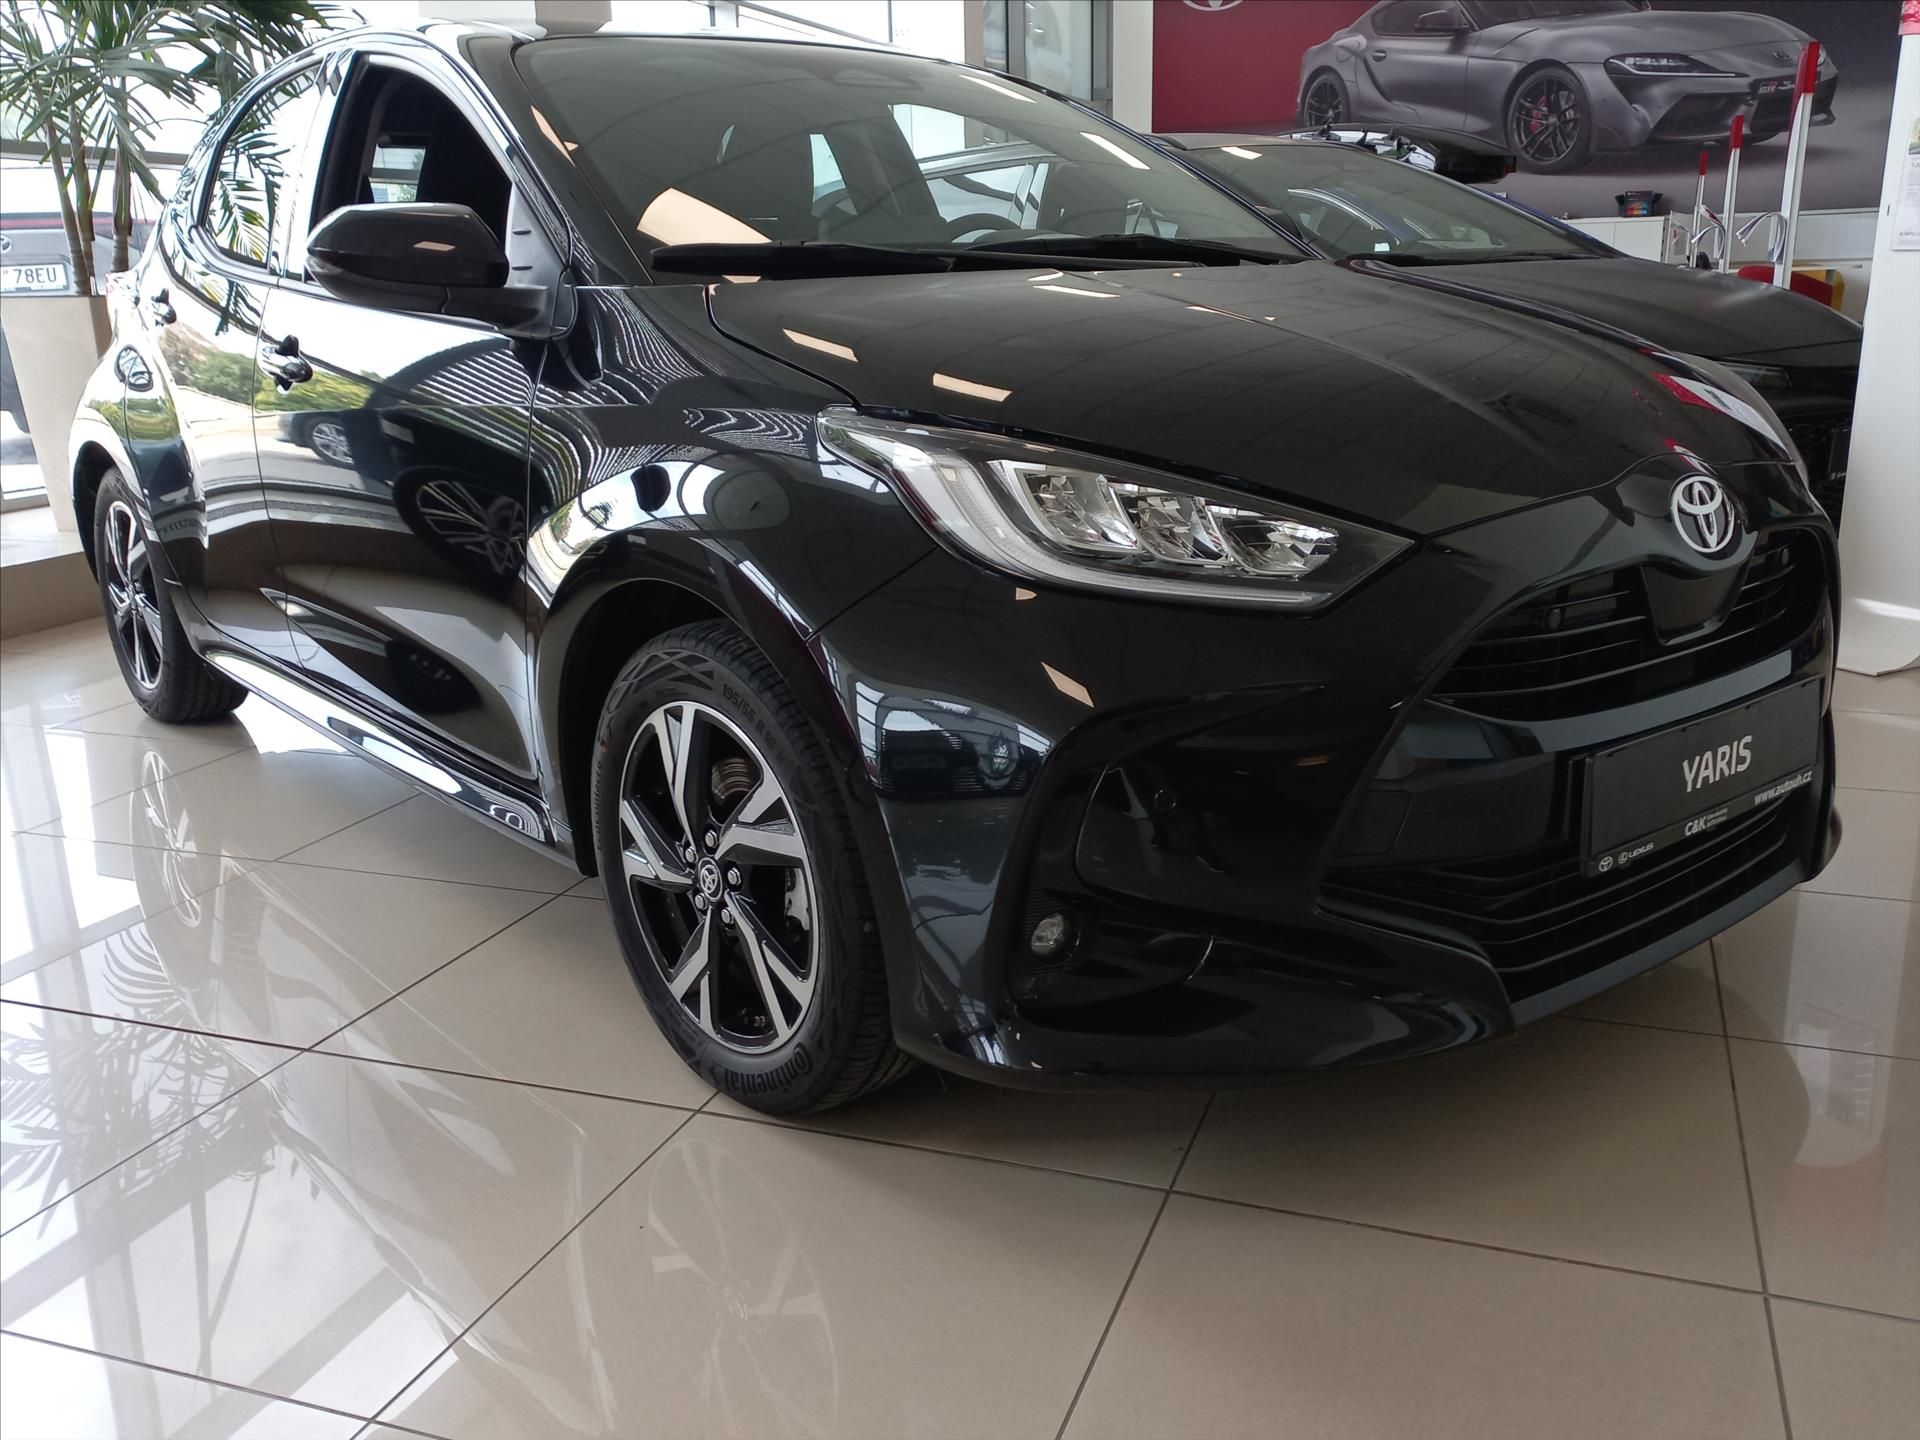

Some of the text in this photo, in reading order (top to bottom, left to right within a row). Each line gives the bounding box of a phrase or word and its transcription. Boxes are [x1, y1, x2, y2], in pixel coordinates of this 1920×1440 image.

[13, 267, 57, 284] 78EU
[1682, 735, 1753, 793] YARIS
[723, 1042, 813, 1096] Continental
